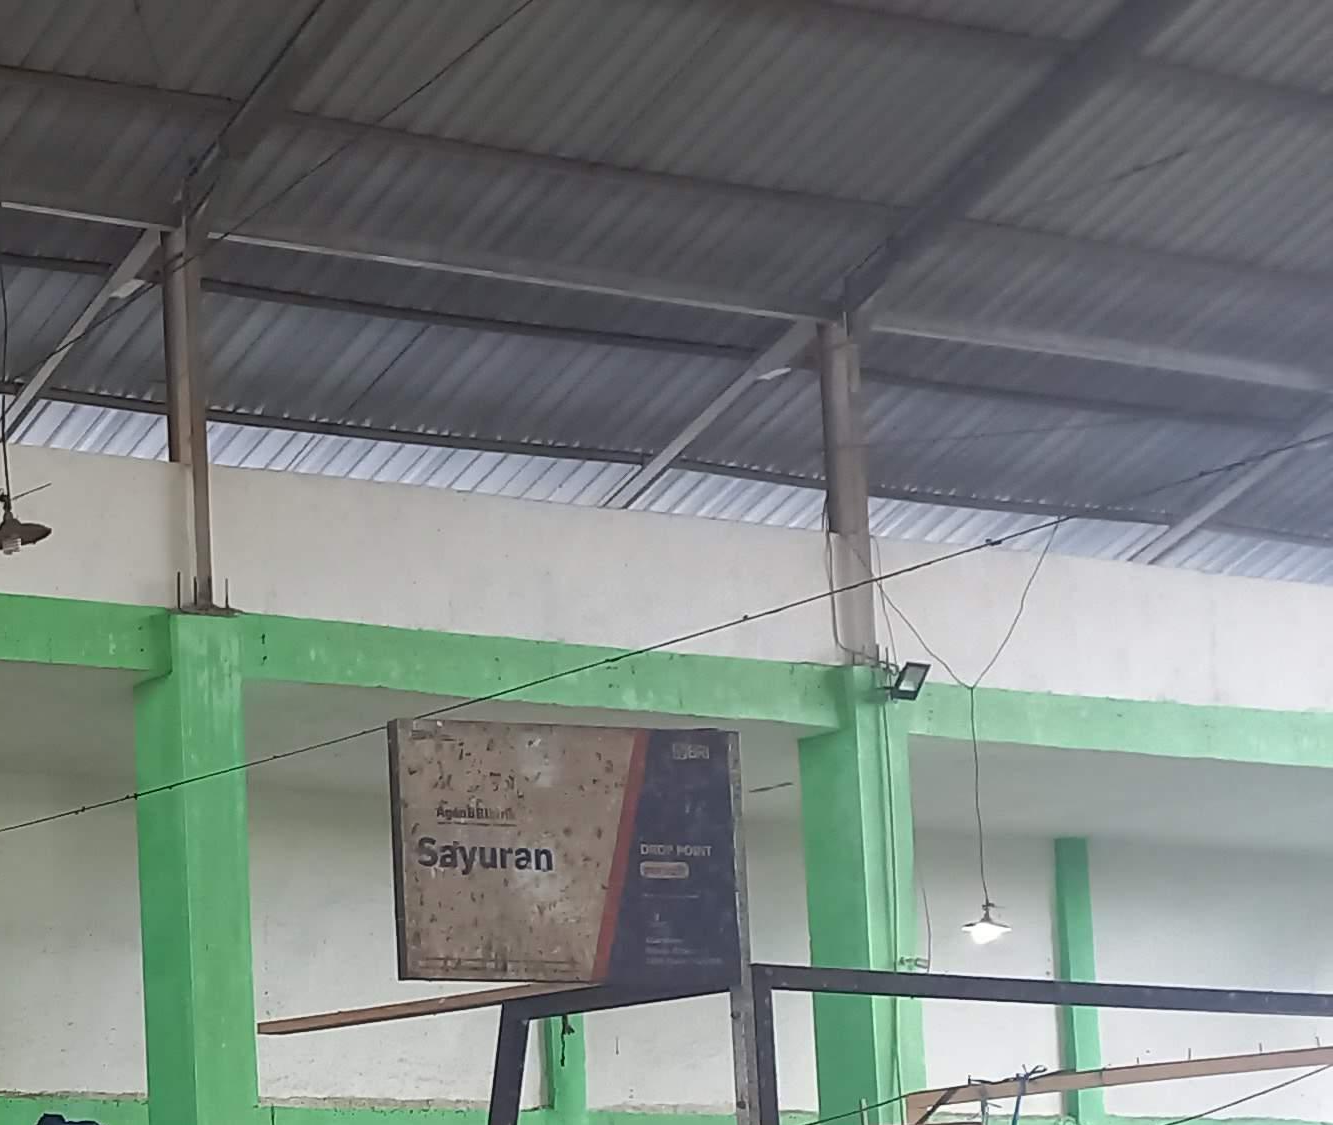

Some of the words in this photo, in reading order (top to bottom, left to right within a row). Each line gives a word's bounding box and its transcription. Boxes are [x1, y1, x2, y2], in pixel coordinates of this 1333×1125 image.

[418, 837, 553, 875] Sayuran
[640, 843, 673, 855] DROP
[676, 844, 712, 857] POINT
